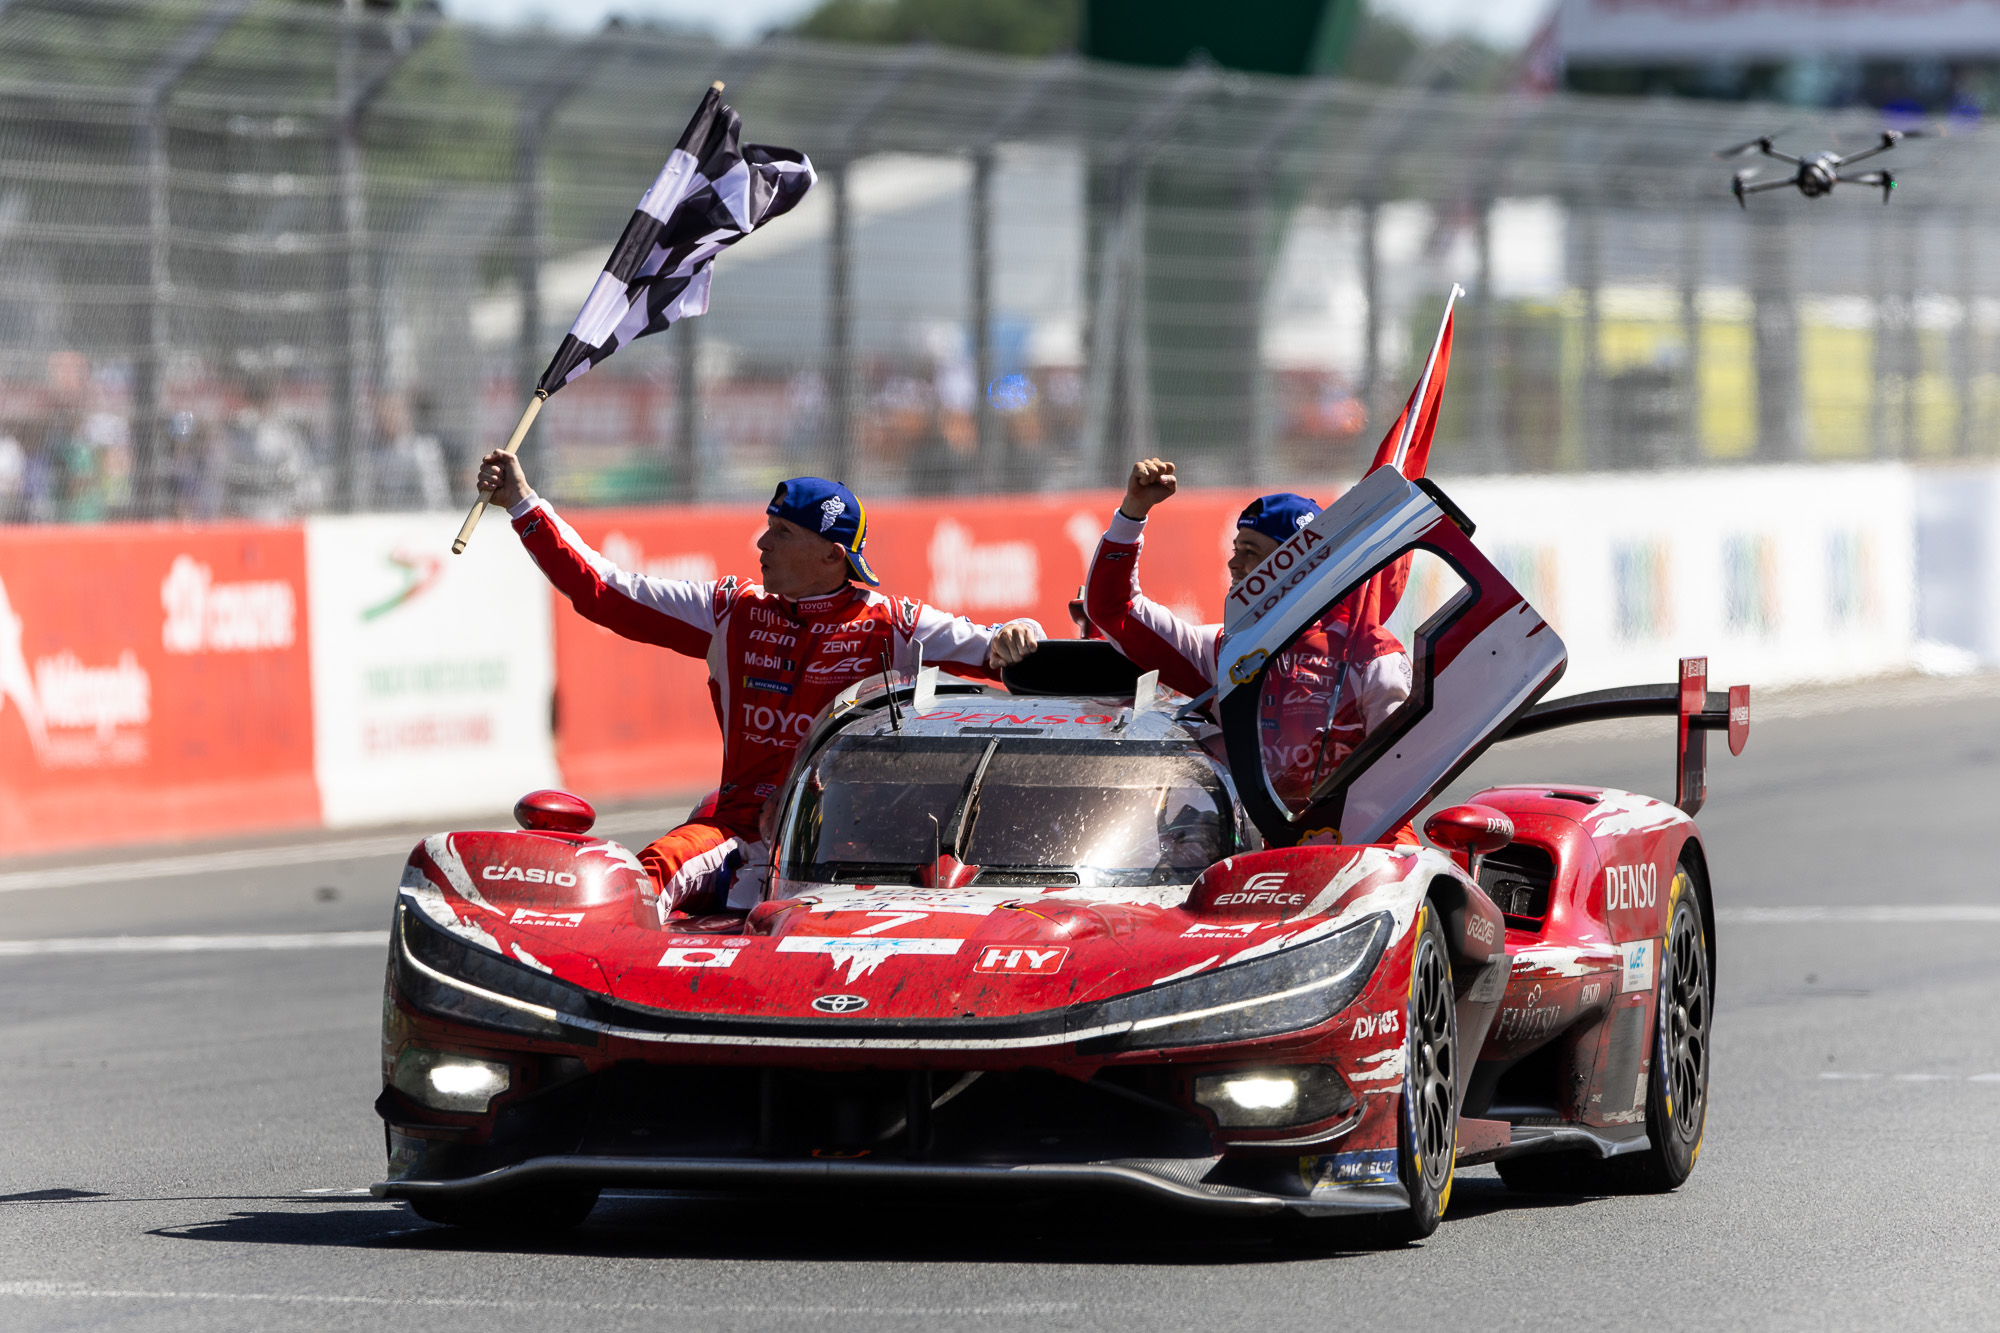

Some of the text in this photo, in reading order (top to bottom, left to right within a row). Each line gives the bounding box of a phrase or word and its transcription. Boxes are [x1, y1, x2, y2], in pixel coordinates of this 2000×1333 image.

[1230, 528, 1324, 607] TOYOTA
[799, 601, 834, 610] TOYOTA
[810, 619, 876, 634] DENSO
[749, 630, 797, 647] AISIN
[822, 640, 861, 654] ZENT
[744, 651, 782, 670] Mobil
[806, 657, 873, 674] WEC
[1297, 652, 1341, 670] ENS
[754, 681, 789, 692] MICHELIN
[1296, 671, 1333, 687] ZENT
[743, 703, 814, 737] TOYO
[912, 711, 1113, 726] DENSO
[742, 732, 799, 749] RAC
[1263, 741, 1354, 768] YOA
[1486, 817, 1515, 836] DENSO
[482, 865, 577, 888] CASIO
[1605, 862, 1657, 911] DENSO
[1214, 892, 1306, 906] EDIFICE
[509, 919, 580, 928] MARELLI
[851, 911, 930, 936] 7
[1466, 914, 1496, 945] RAYS
[982, 949, 1062, 969] HY
[1629, 946, 1646, 970] WEC
[1494, 1005, 1561, 1041] FUJITSU
